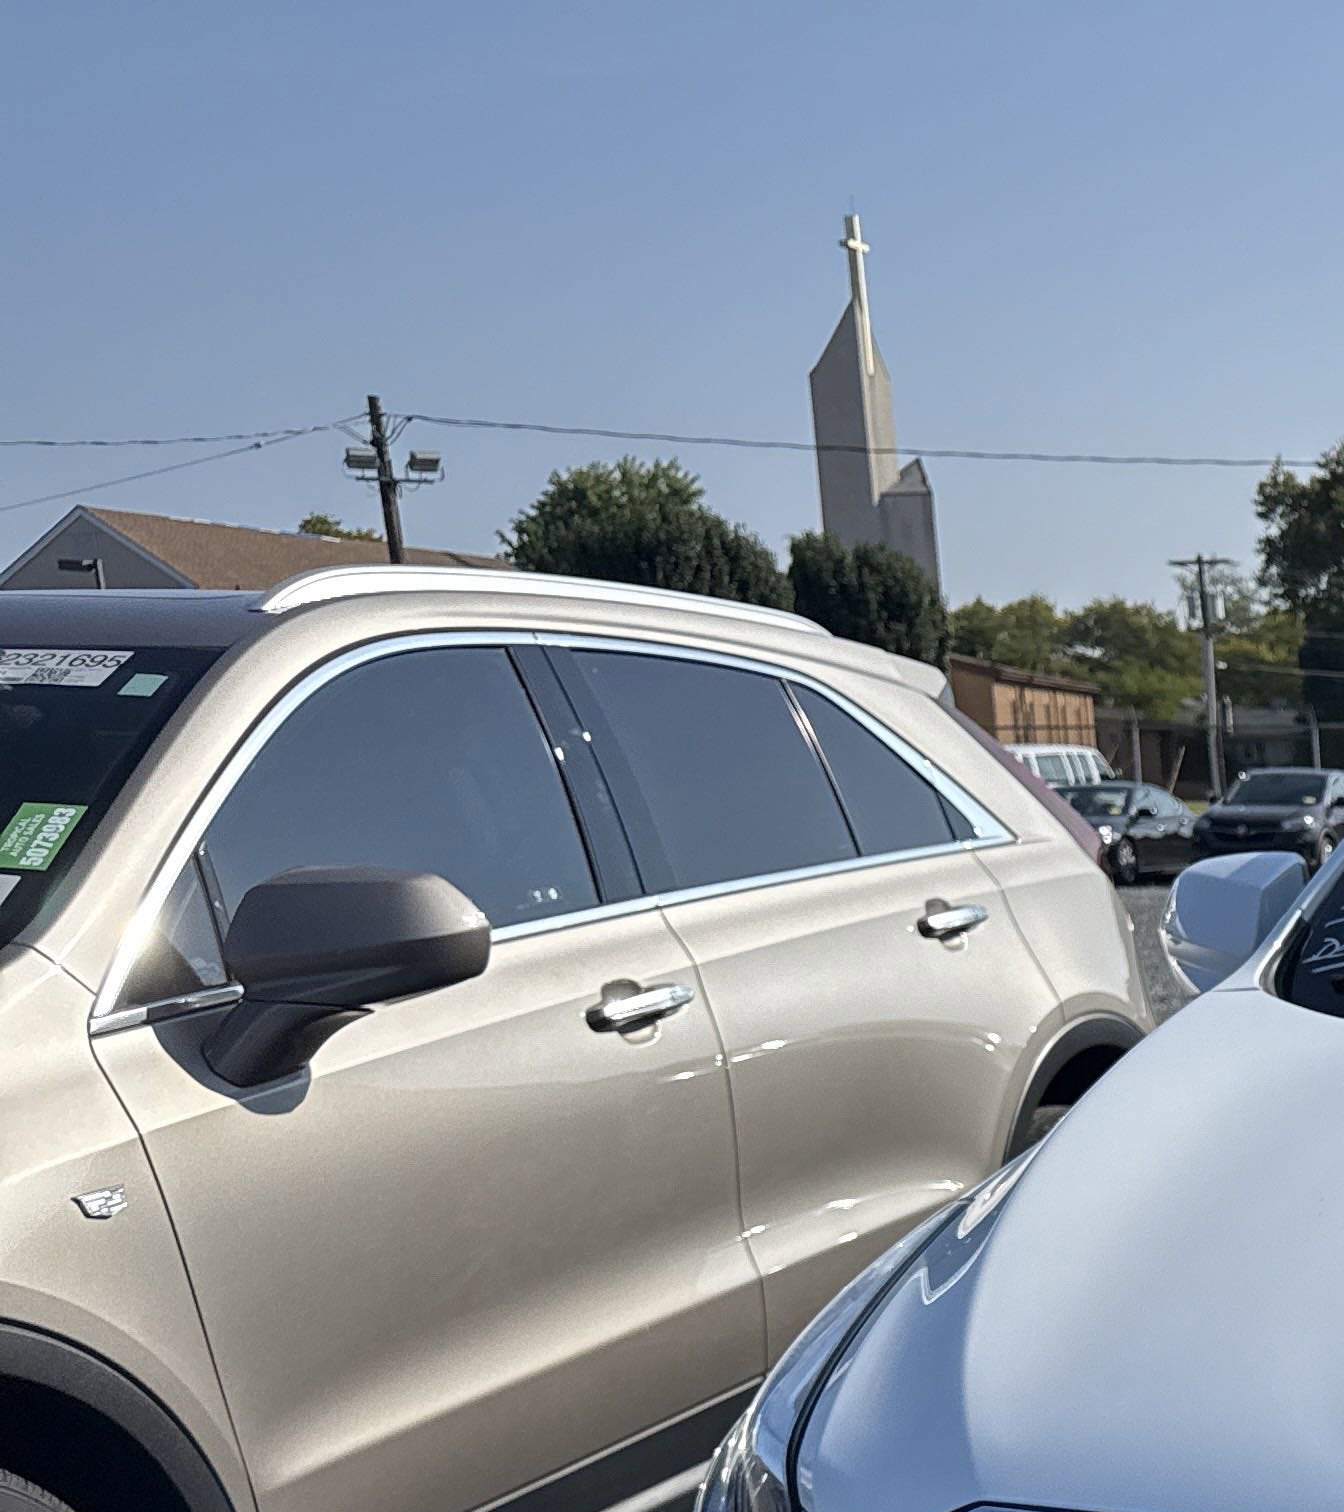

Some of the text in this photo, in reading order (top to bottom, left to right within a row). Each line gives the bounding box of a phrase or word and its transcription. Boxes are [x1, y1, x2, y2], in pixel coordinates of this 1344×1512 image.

[10, 813, 46, 857] AUTO SALES
[19, 807, 77, 866] 5073983
